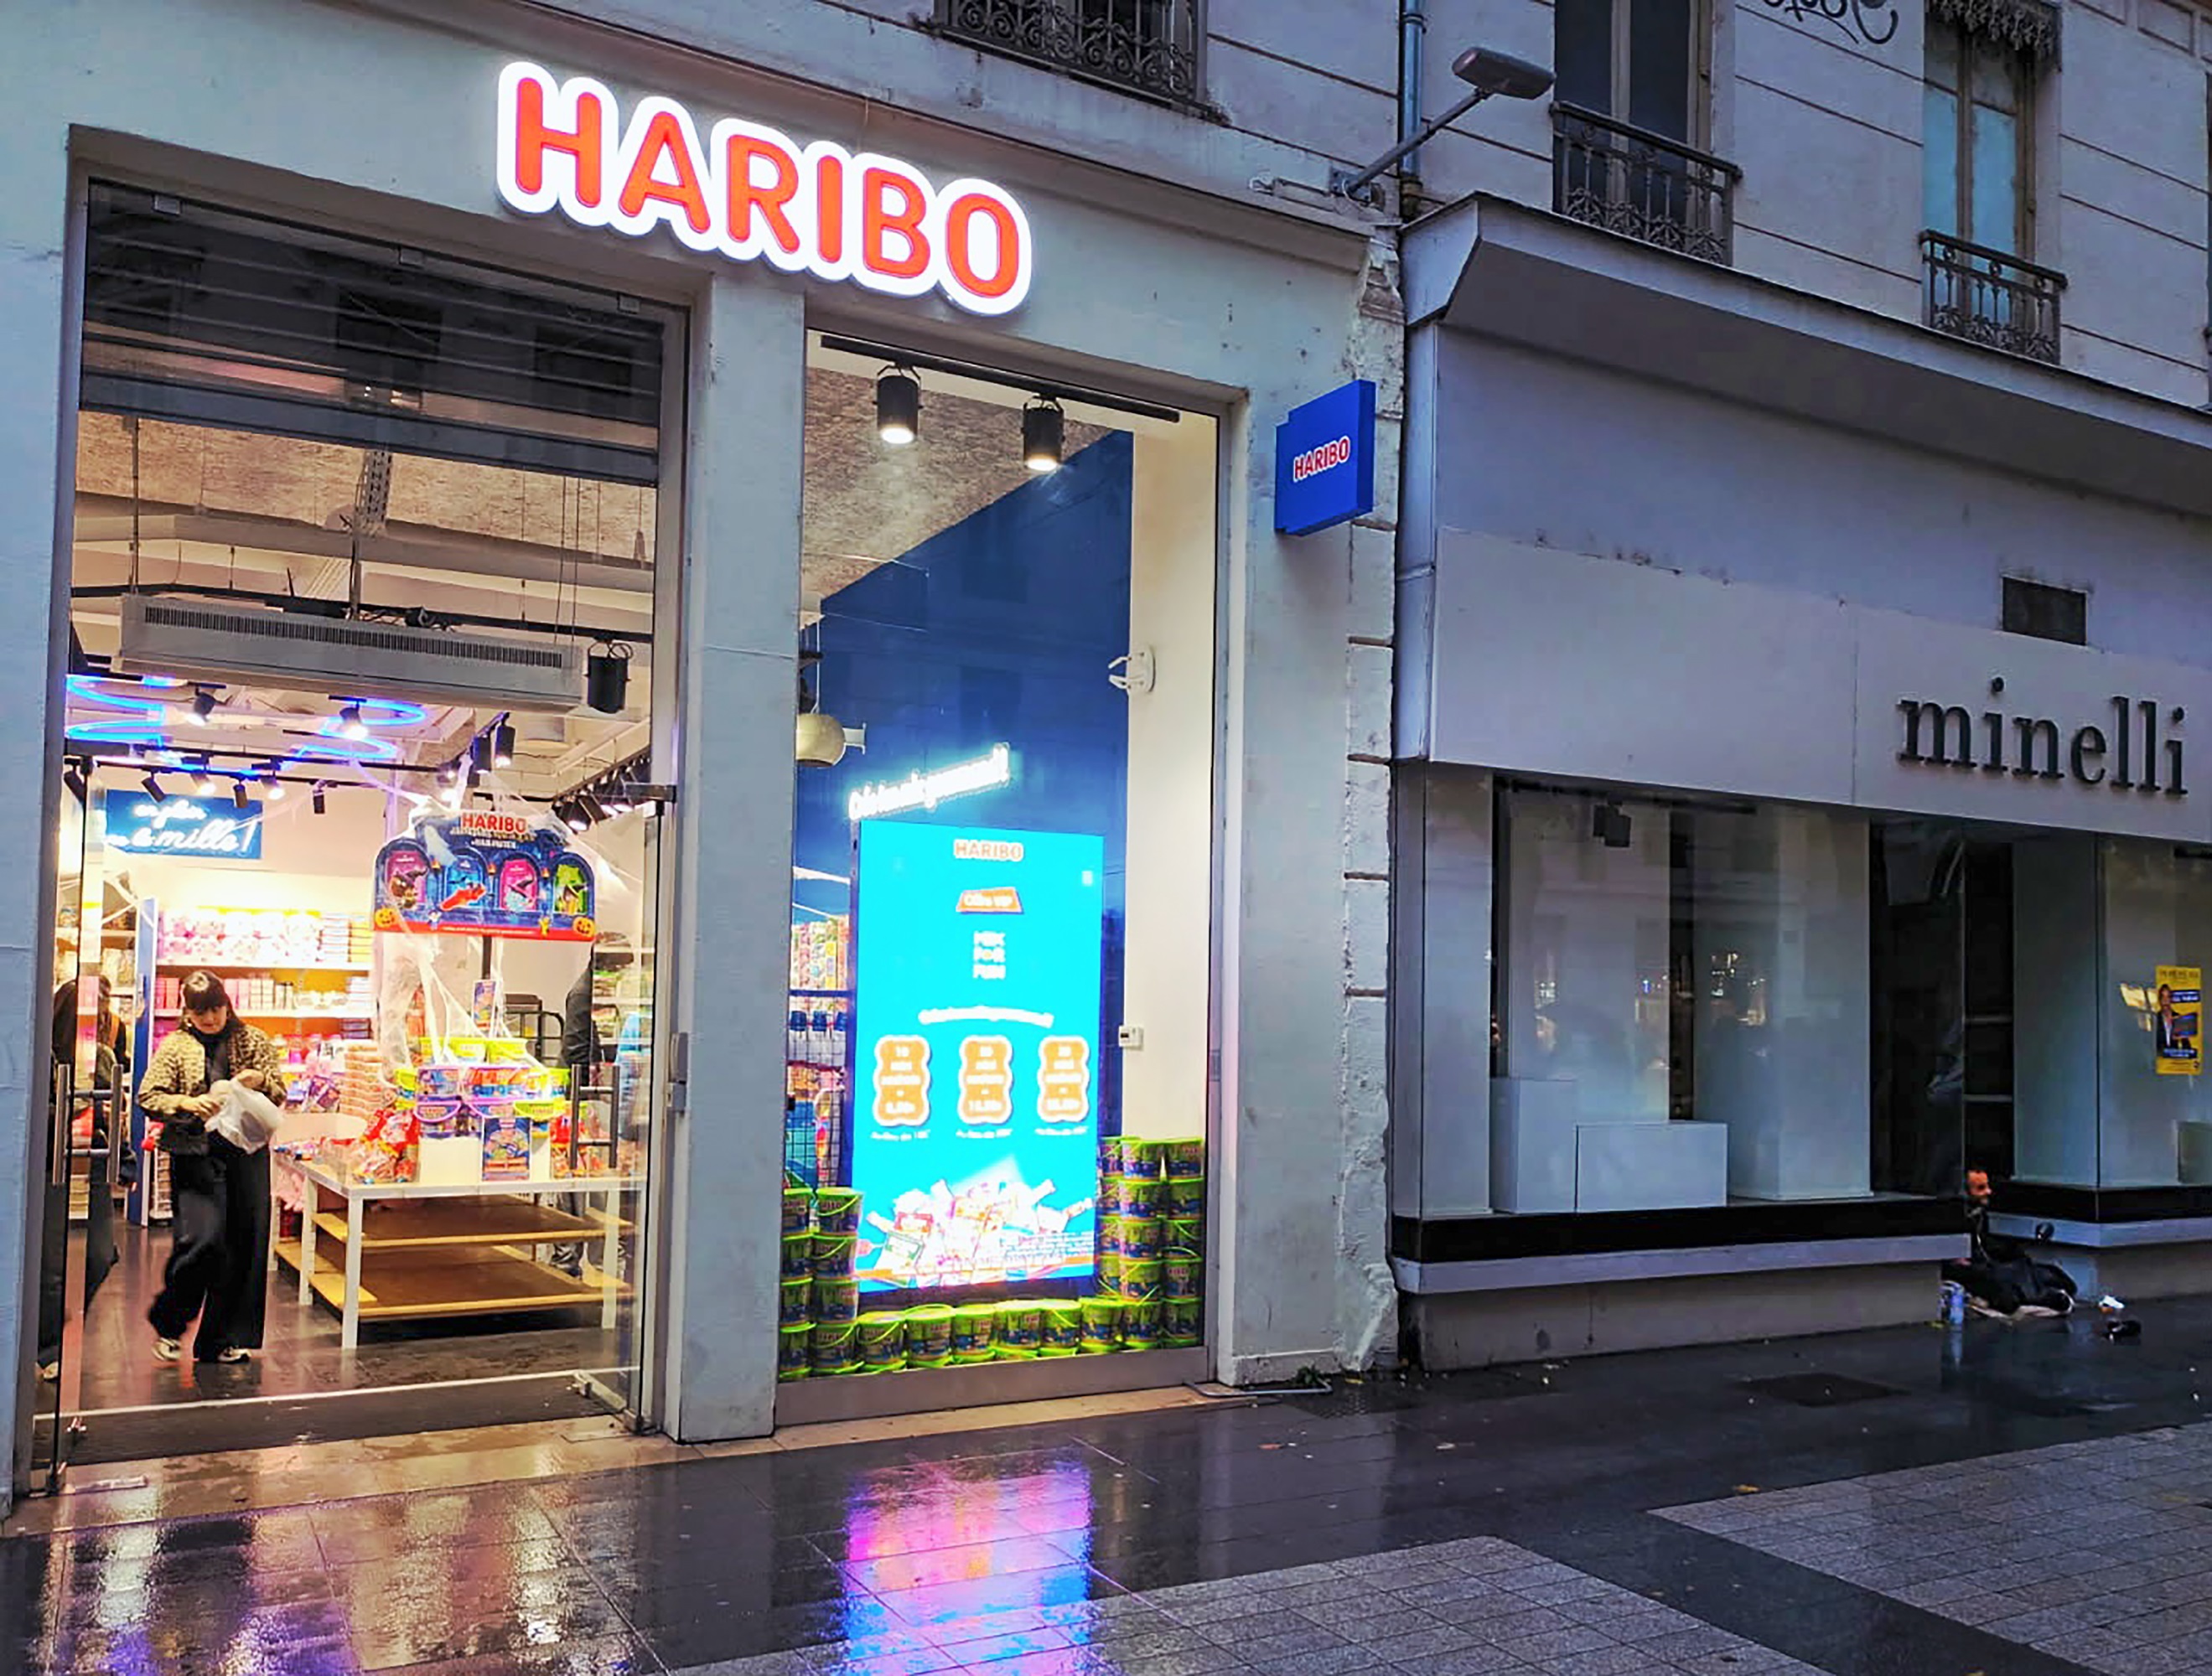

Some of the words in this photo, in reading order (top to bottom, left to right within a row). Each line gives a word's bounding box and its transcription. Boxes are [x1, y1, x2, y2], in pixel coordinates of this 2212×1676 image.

[513, 75, 1021, 299] HARIBO
[1293, 437, 1350, 479] HARIBO
[1897, 676, 2189, 796] minelli
[461, 812, 527, 834] HARIBO
[954, 840, 1023, 860] HARIBO
